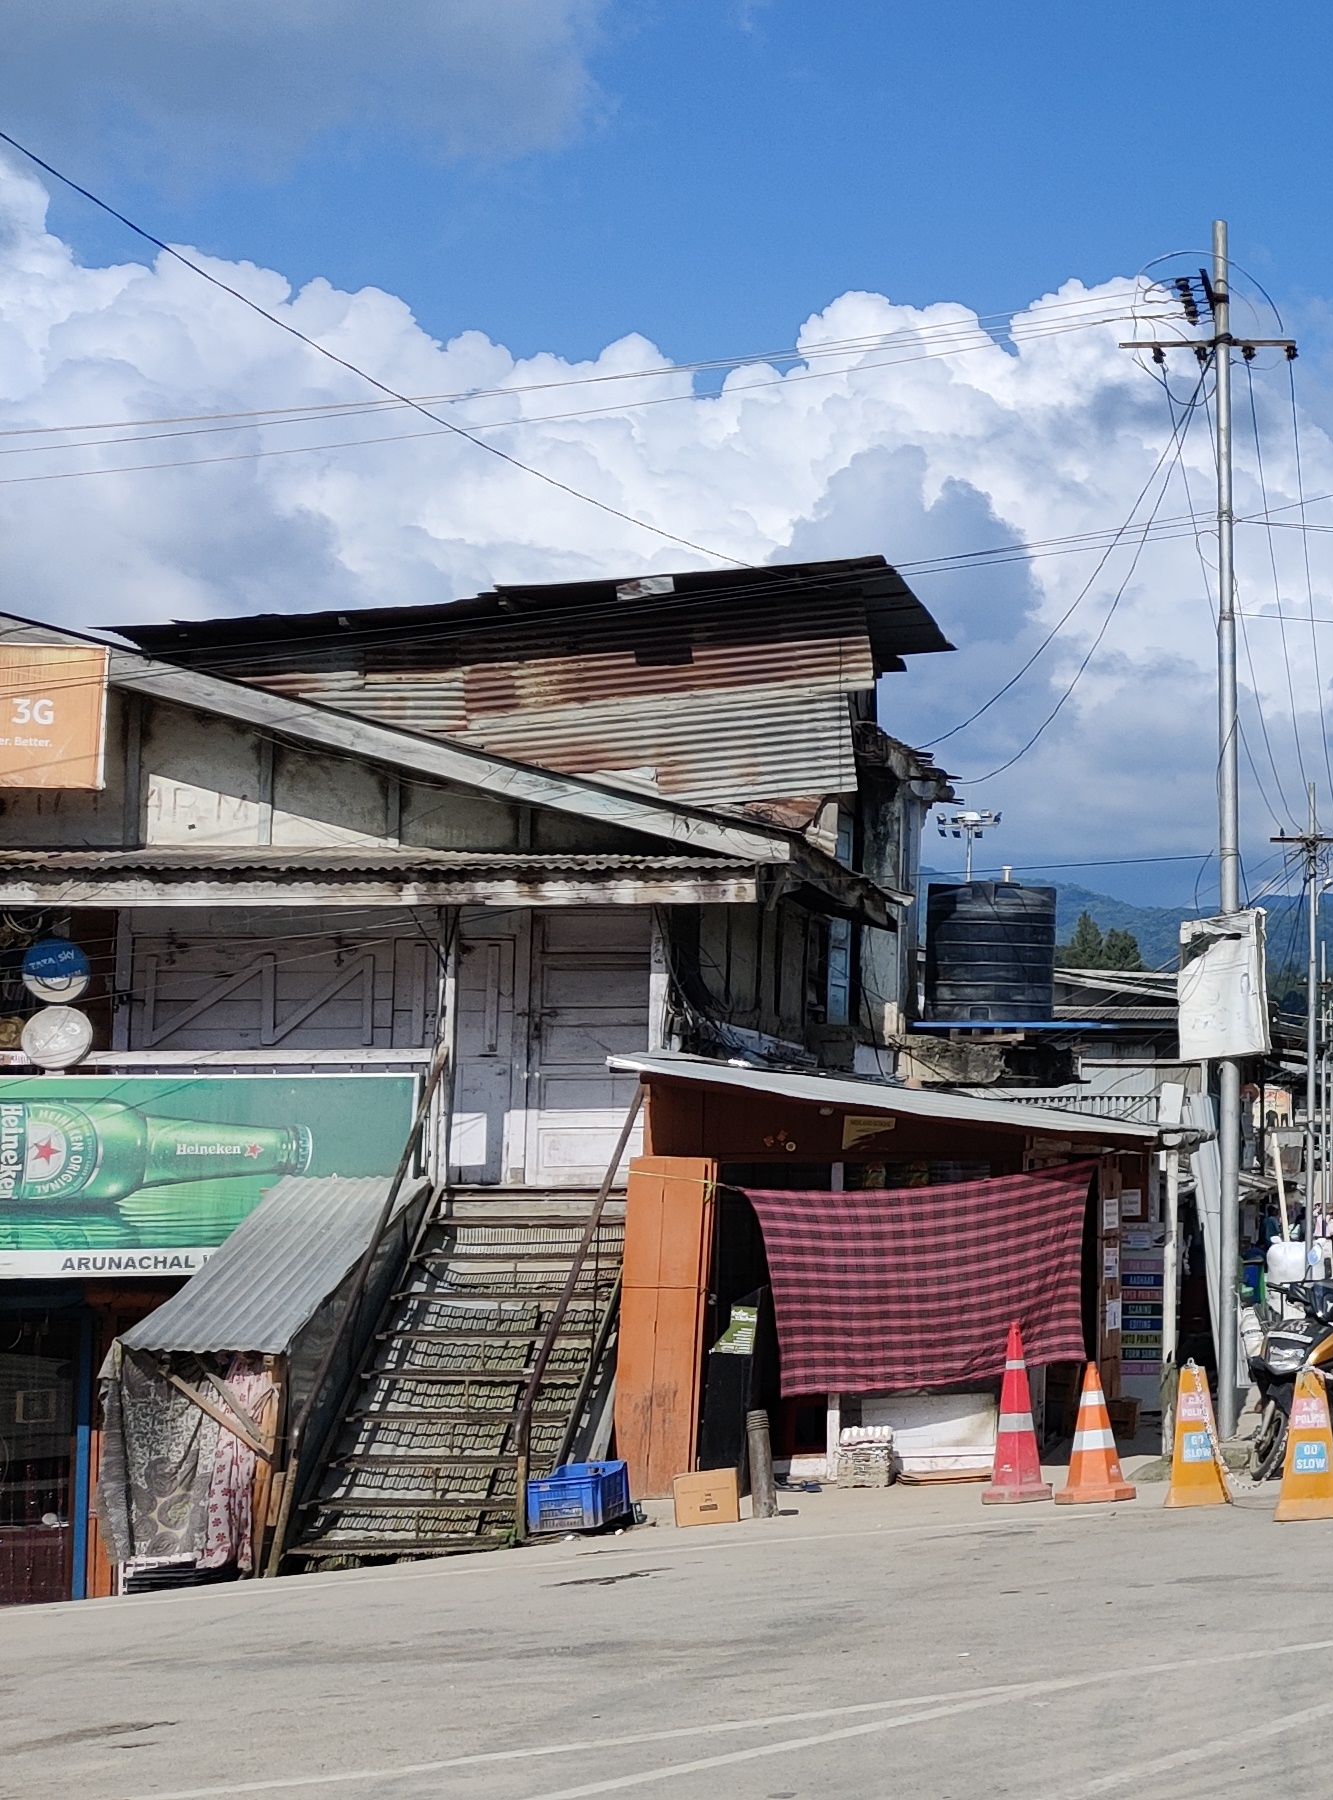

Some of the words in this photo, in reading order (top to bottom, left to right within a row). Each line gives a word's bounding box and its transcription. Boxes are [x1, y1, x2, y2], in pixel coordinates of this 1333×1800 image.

[11, 699, 54, 725] 3G
[14, 737, 53, 748] Better.
[29, 956, 56, 970] TATA
[39, 1109, 84, 1152] HEINEKEN
[0, 1104, 24, 1200] Heineken
[176, 1143, 241, 1156] Heineken
[35, 1155, 83, 1193] ORIGINAL
[61, 1255, 196, 1272] ARUNACHAL
[1129, 1275, 1154, 1285] AADHAAR
[1129, 1320, 1151, 1329] EDITING
[1295, 1413, 1326, 1424] POLICE
[1191, 1435, 1204, 1446] GO
[1185, 1447, 1213, 1458] SLOW
[1303, 1444, 1318, 1455] GO
[1296, 1459, 1326, 1470] SLOW
